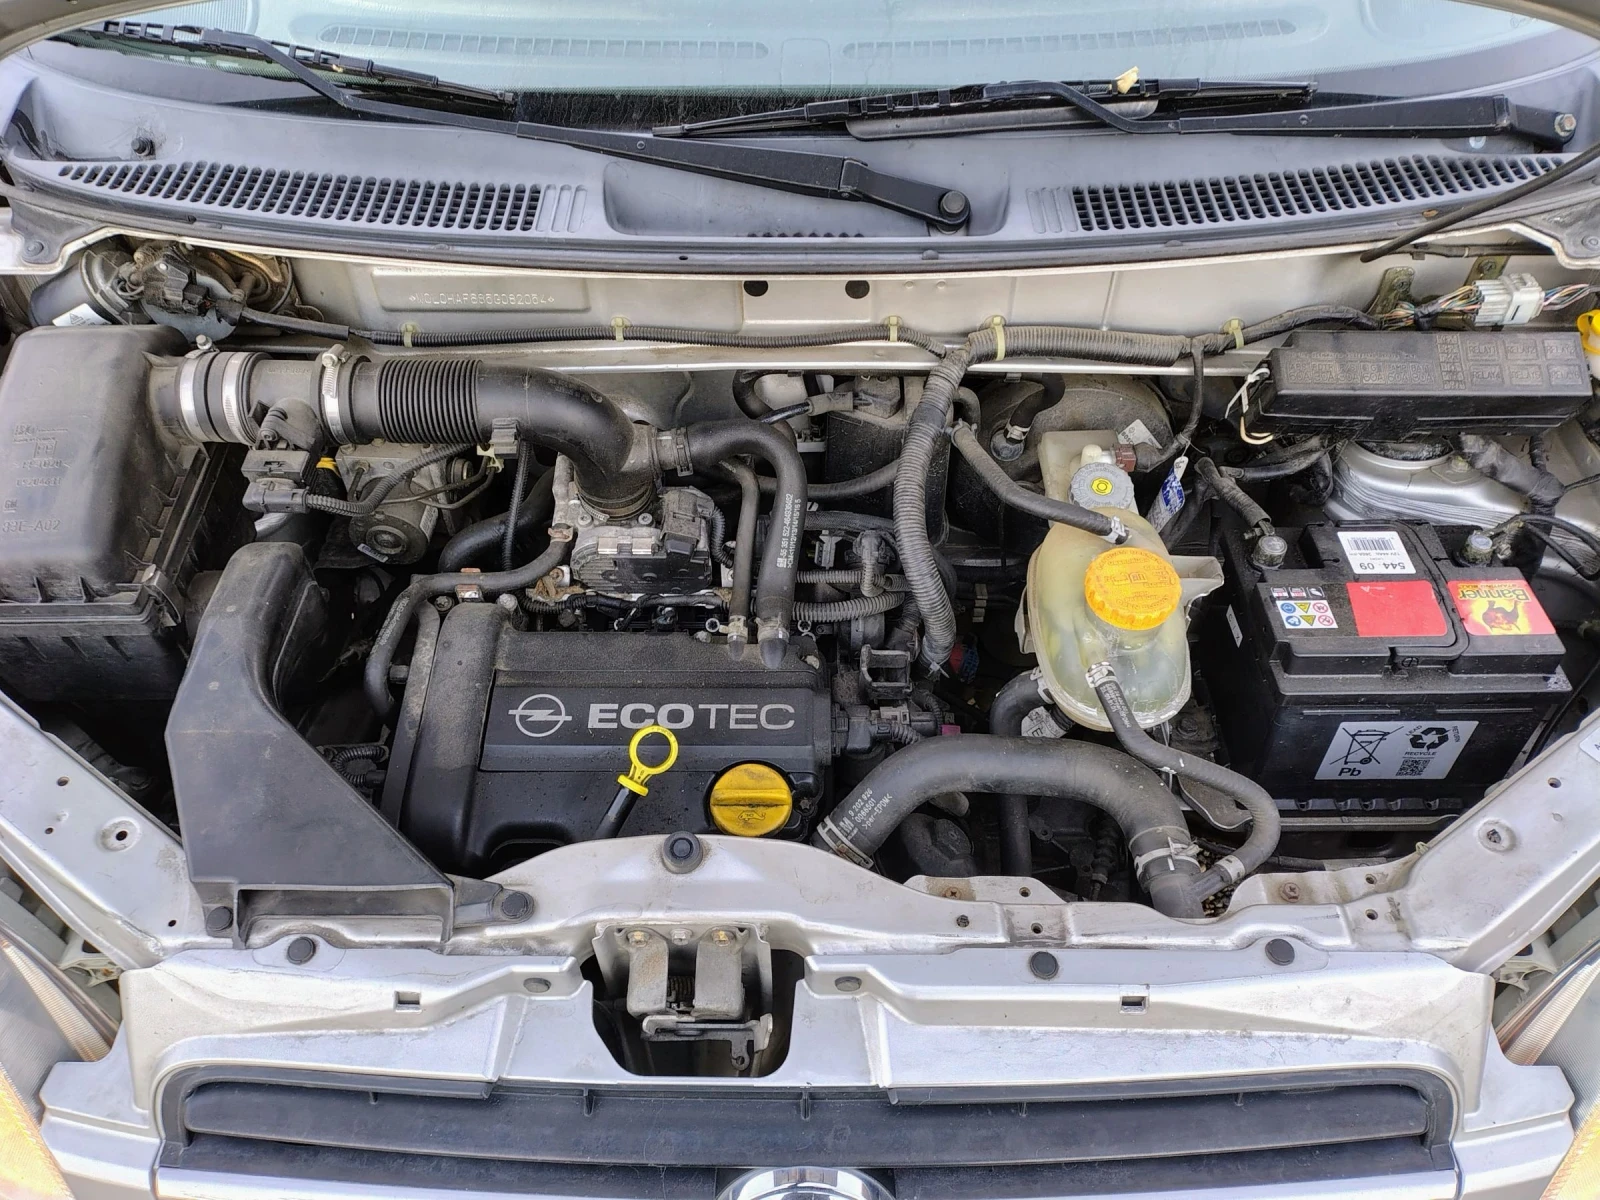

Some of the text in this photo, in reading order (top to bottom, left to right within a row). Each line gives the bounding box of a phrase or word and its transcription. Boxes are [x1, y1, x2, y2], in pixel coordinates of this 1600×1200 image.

[1360, 562, 1406, 570] 544 09
[1460, 588, 1530, 601] Banner
[587, 703, 795, 730] ECOTEC
[1405, 725, 1423, 737] LEAD
[1452, 726, 1460, 743] RETURN
[1338, 767, 1362, 777] Pb
